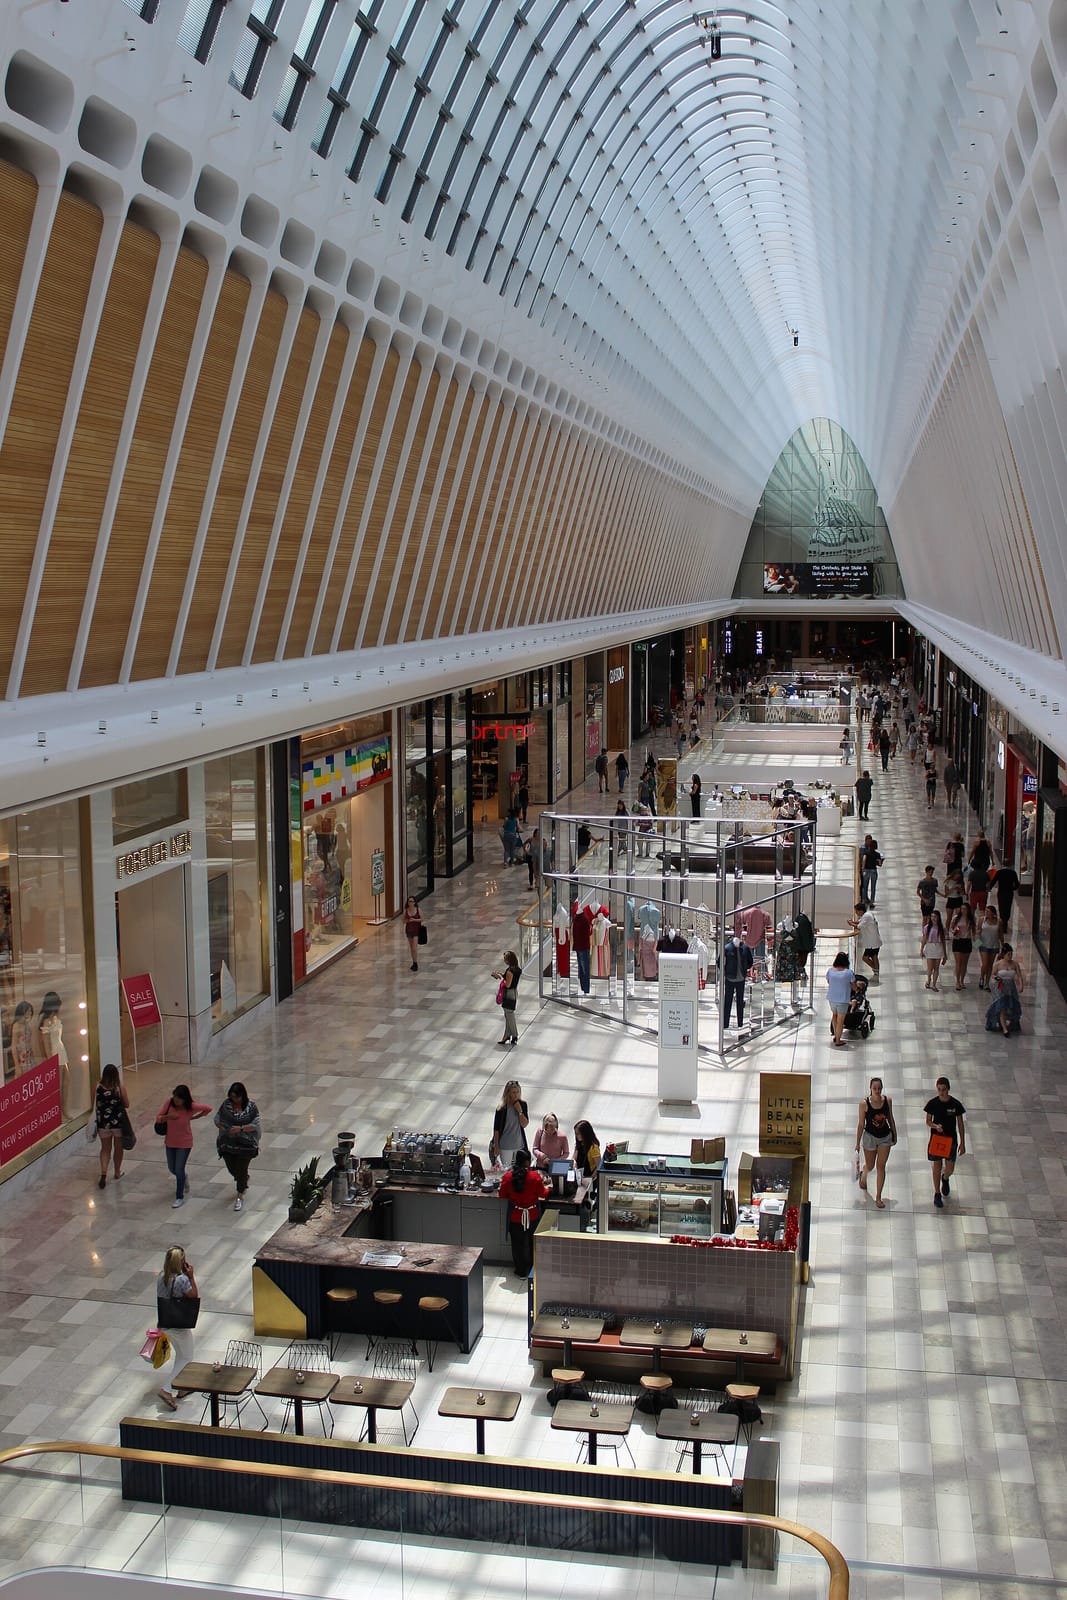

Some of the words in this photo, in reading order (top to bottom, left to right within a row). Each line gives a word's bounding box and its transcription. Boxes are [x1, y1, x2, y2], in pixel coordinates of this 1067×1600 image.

[116, 840, 168, 879] FOREVER
[170, 830, 192, 857] NEW
[130, 989, 152, 1003] SALE
[0, 1098, 9, 1112] UP
[11, 1092, 20, 1104] TO
[22, 1075, 43, 1101] 50%
[45, 1068, 57, 1083] OFF
[768, 1097, 804, 1109] LITTLE
[768, 1111, 803, 1122] BEAN
[2, 1133, 16, 1150] NEW
[18, 1119, 38, 1139] STYLES
[39, 1105, 60, 1125] ADDED
[767, 1123, 803, 1136] BLUE
[936, 1143, 946, 1152] T2
